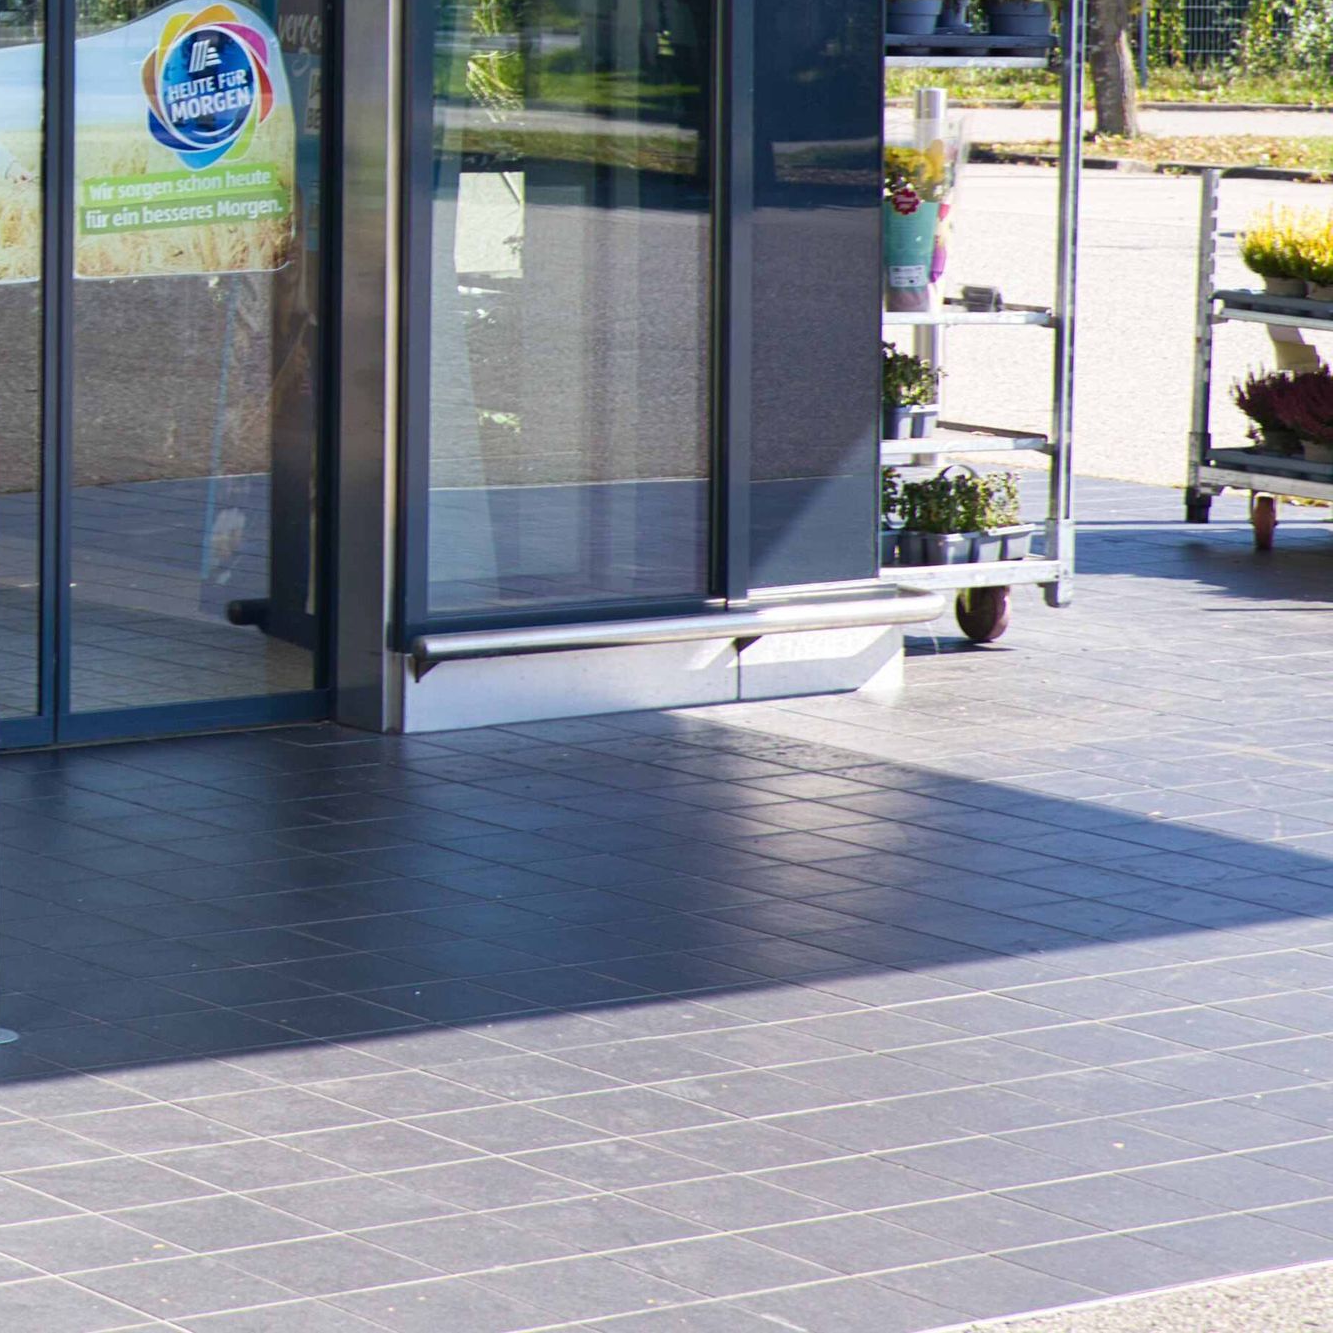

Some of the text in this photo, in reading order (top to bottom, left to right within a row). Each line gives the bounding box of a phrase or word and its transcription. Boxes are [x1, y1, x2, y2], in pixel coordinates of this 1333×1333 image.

[166, 69, 248, 102] HEUTE FÜR
[170, 86, 251, 123] MORGEN
[89, 170, 272, 201] Wir sorgen schon heute
[85, 199, 284, 229] für ein besseres Morgen.
